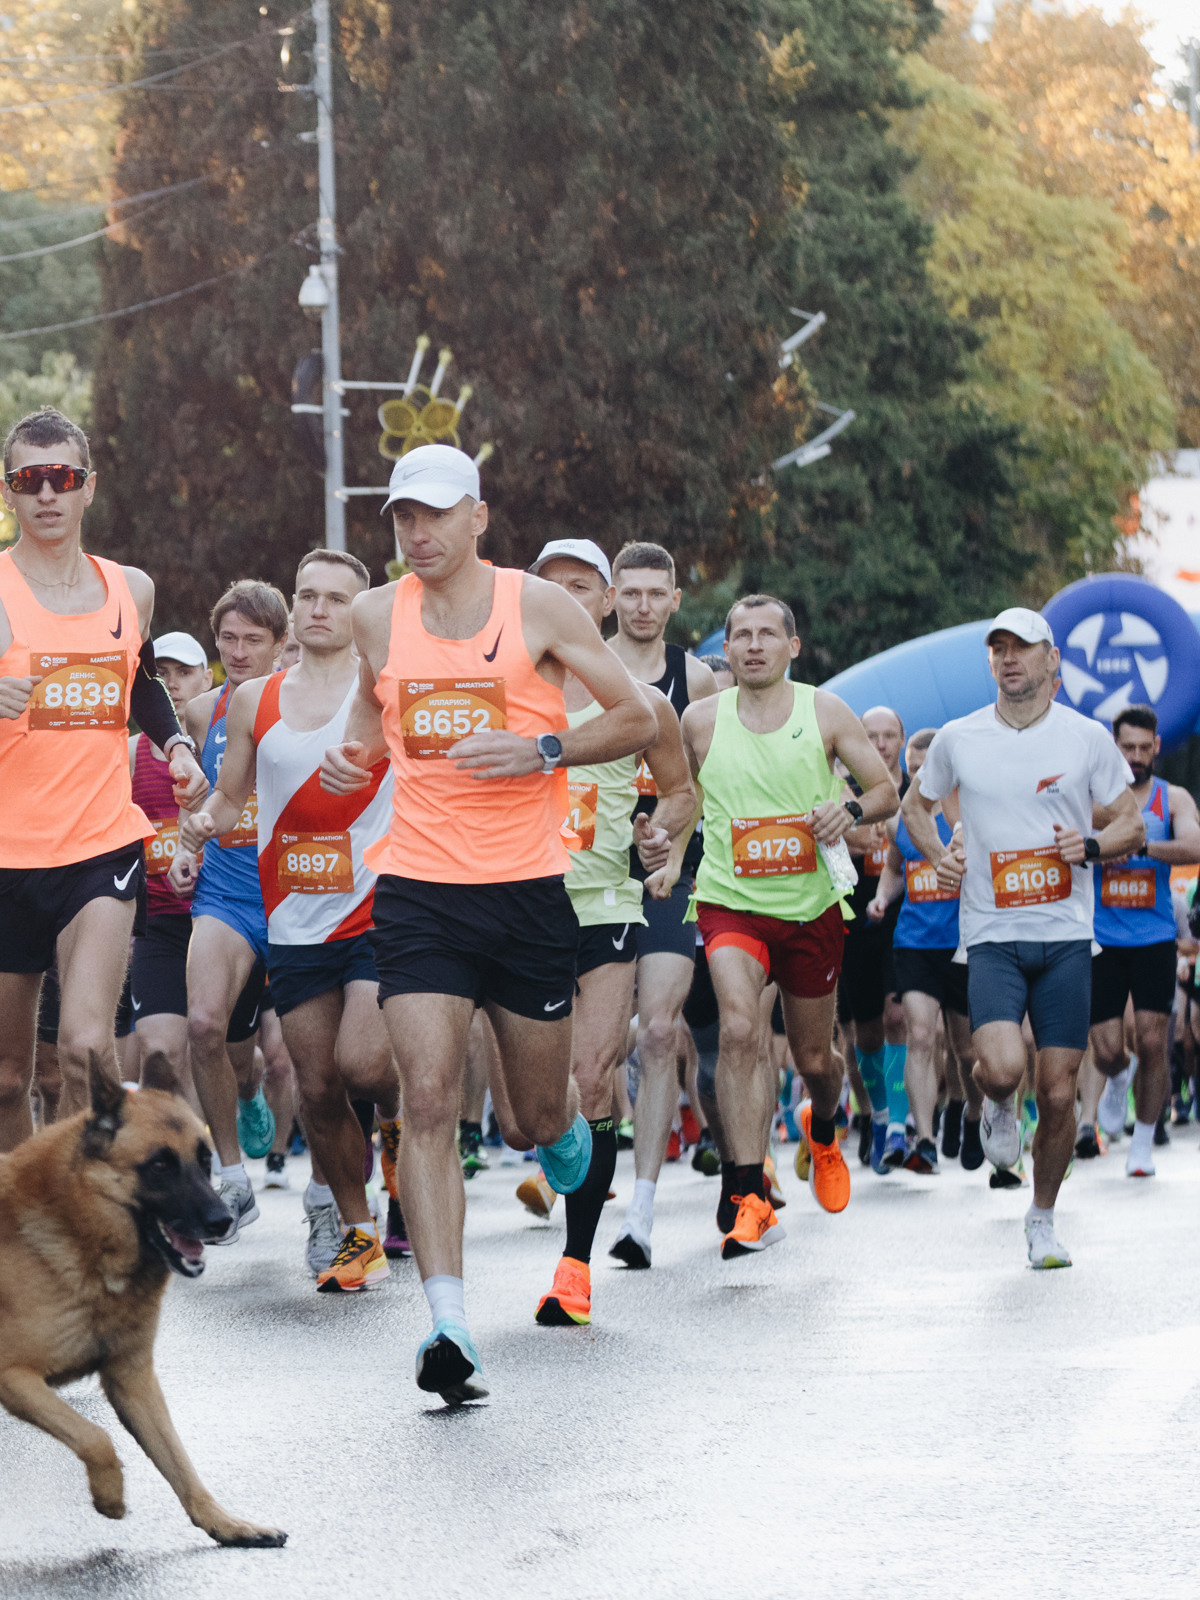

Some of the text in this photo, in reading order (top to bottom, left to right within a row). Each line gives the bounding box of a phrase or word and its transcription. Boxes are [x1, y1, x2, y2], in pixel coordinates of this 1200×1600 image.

[90, 655, 121, 663] MARATHON
[69, 672, 96, 680] ДЕНИС
[44, 681, 120, 707] 8839
[413, 708, 492, 735] 8652
[151, 839, 177, 859] 90
[746, 837, 801, 860] 9179
[286, 852, 339, 873] 8897
[1004, 867, 1060, 892] 8108
